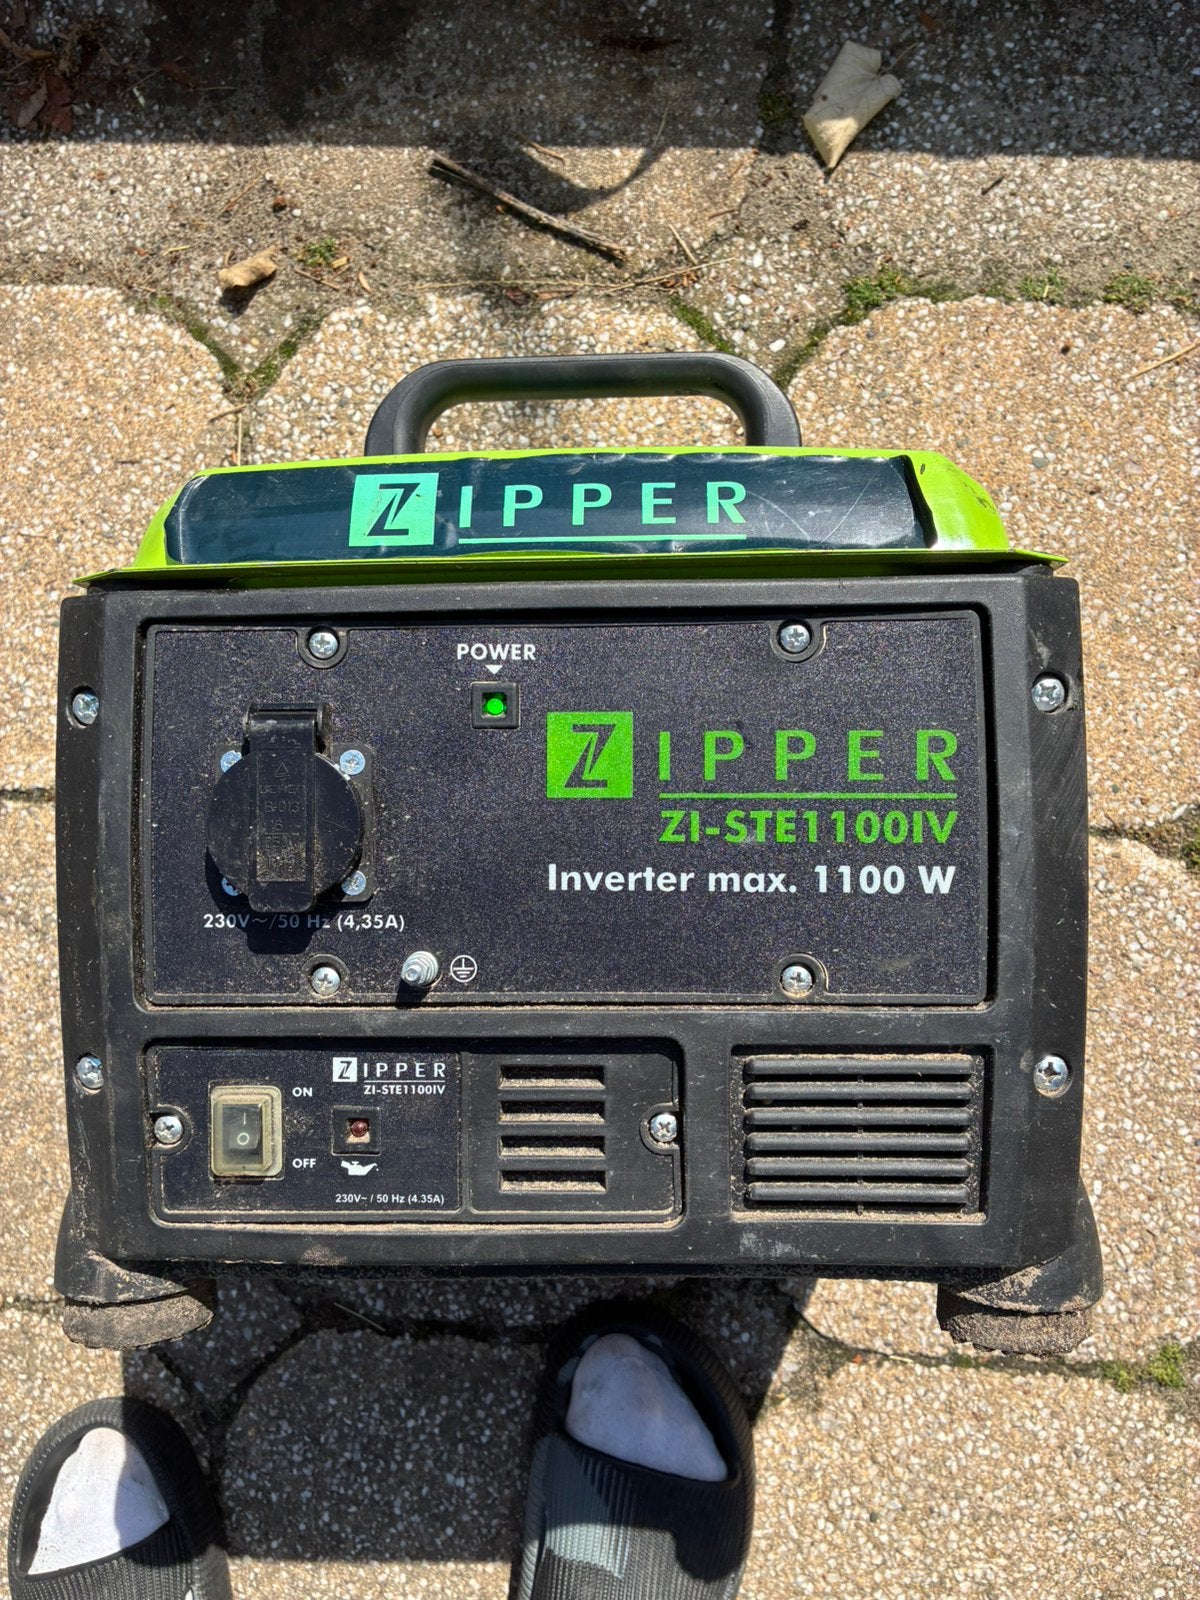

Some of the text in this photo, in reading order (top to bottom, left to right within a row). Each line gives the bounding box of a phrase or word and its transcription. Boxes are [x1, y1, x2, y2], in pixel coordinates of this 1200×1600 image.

[349, 473, 747, 546] ZIPPER
[456, 642, 536, 660] POWER
[547, 711, 958, 799] ZIPPER
[658, 809, 958, 844] ZI-STE1100IV
[546, 863, 957, 894] Inverter max. 1100 W
[307, 914, 331, 929] Hz
[337, 913, 406, 932] (4,35A)
[332, 1056, 446, 1082] ZIPPER
[292, 1087, 313, 1097] ON
[363, 1084, 446, 1095] ZI-STE1100IV
[292, 1158, 317, 1169] OFF
[376, 1194, 389, 1203] 50
[391, 1194, 406, 1203] Hz
[407, 1194, 445, 1205] (4.35A)
